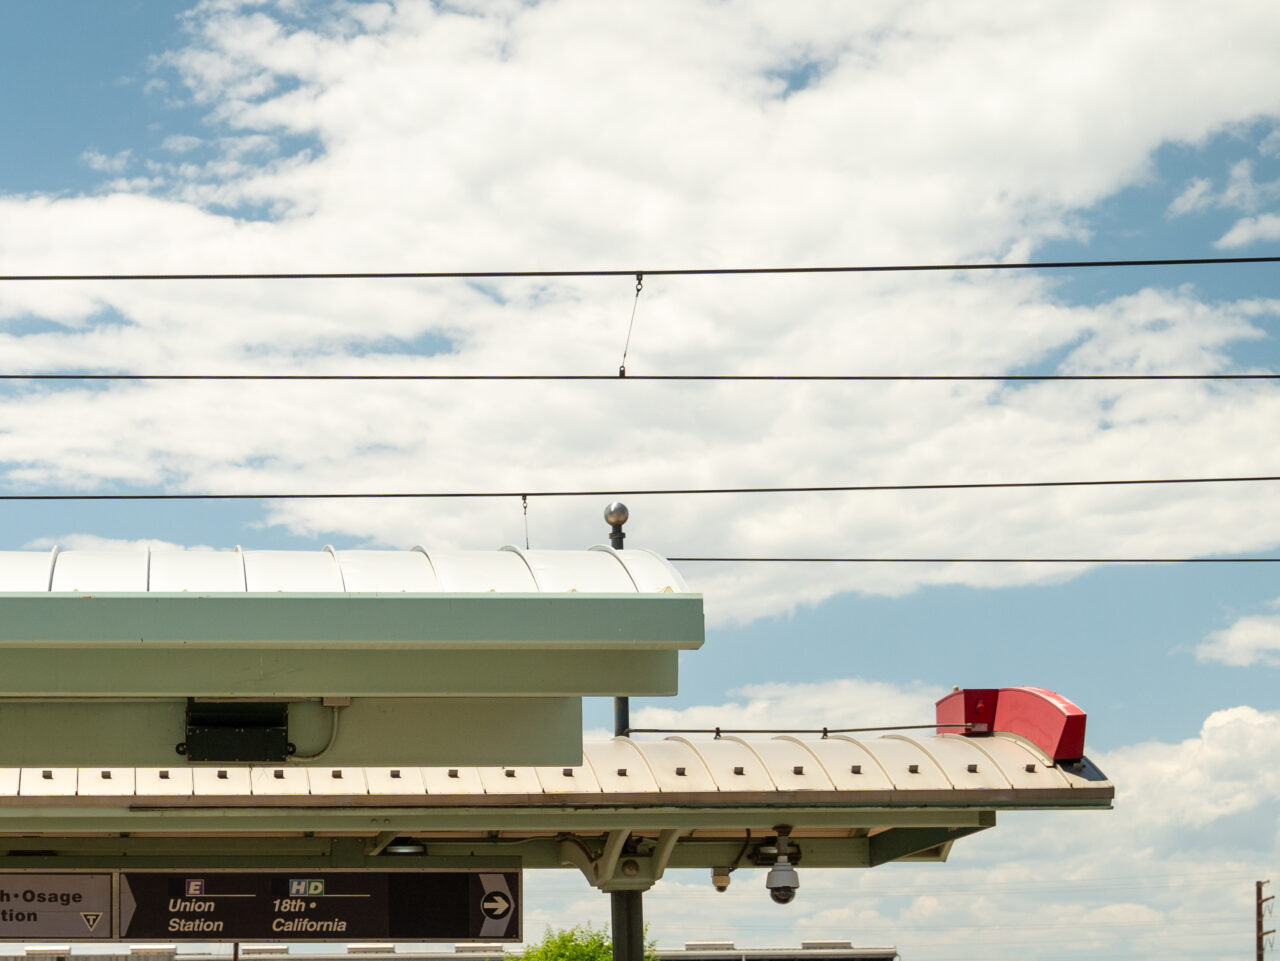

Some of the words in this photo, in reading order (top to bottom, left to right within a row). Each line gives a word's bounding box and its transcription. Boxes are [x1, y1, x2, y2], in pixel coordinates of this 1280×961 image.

[188, 881, 202, 894] E
[169, 899, 215, 912] Union
[273, 899, 305, 912] 18th
[168, 918, 224, 932] Station
[272, 918, 347, 932] California
